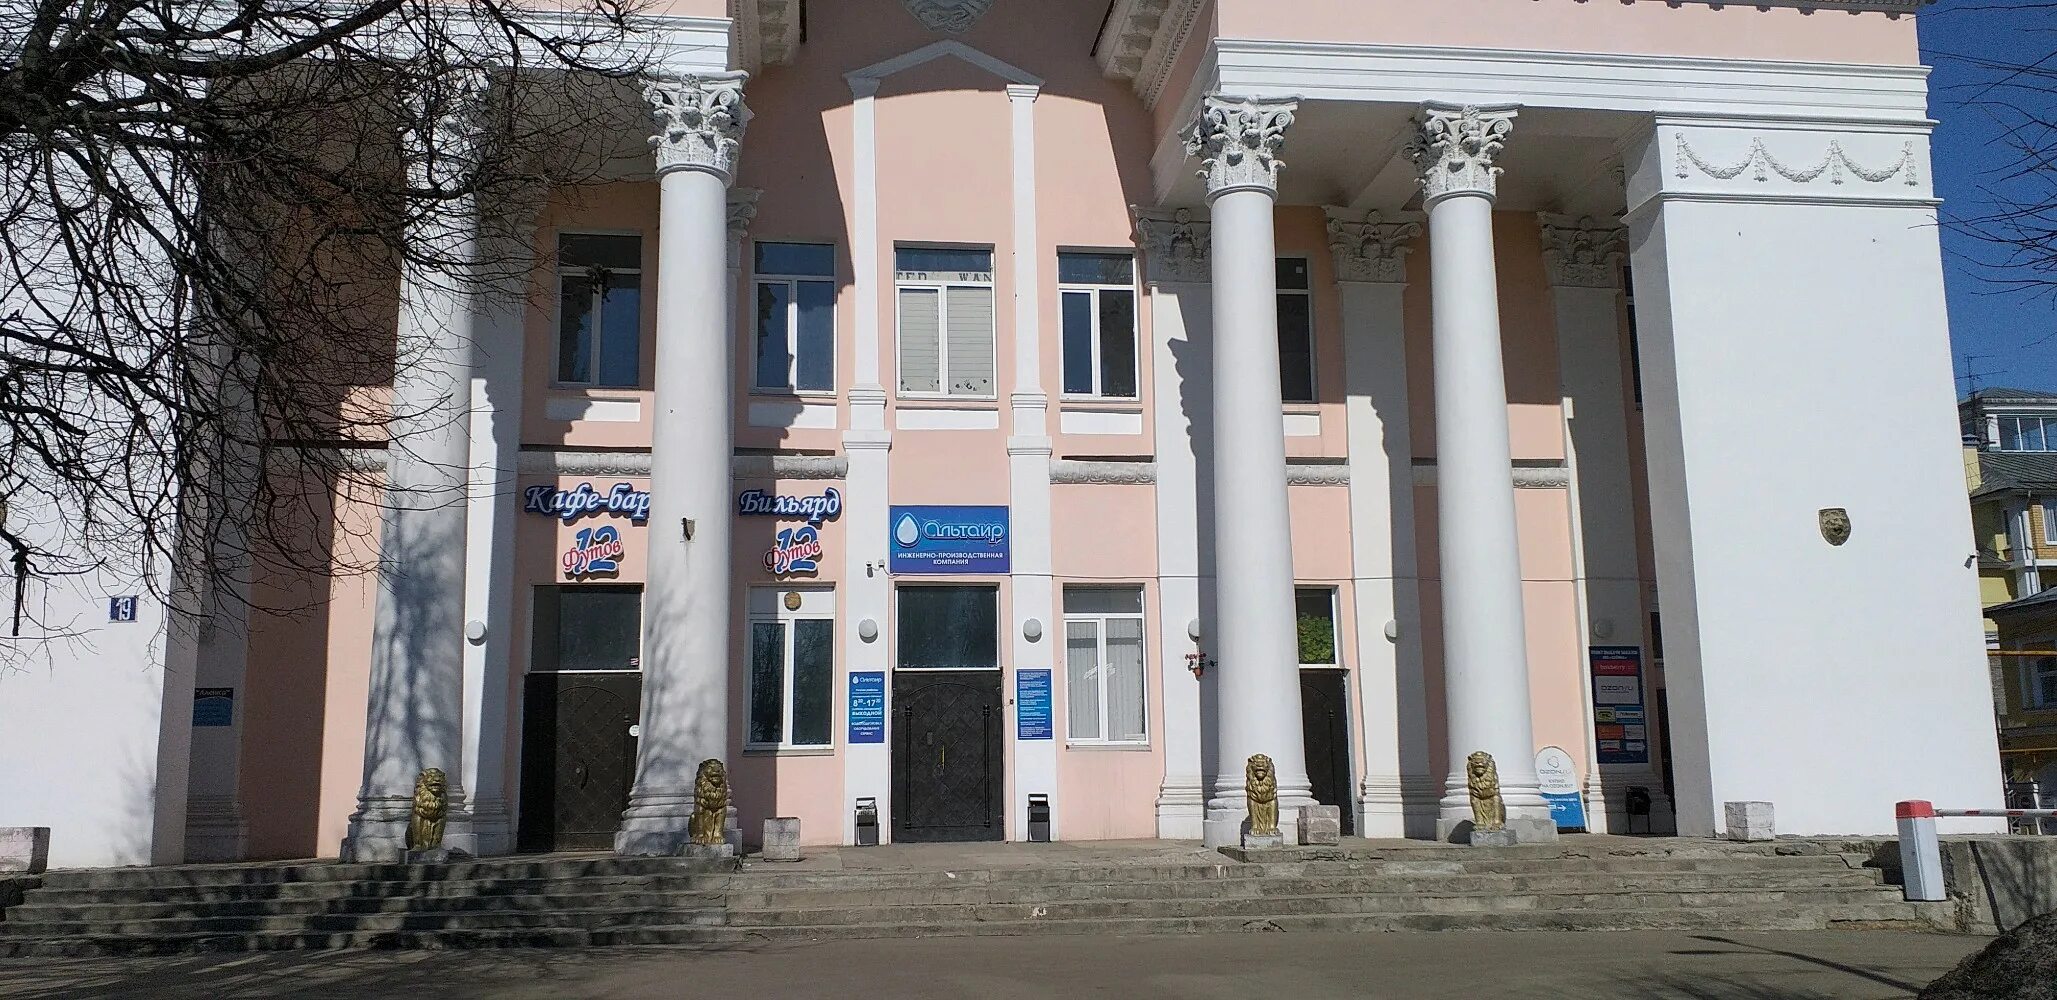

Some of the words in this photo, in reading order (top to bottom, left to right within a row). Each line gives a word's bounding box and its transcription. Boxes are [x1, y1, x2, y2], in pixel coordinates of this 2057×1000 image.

[525, 483, 650, 518] Кафе-бар
[740, 487, 842, 521] Бильярд
[575, 525, 619, 575] 12
[776, 525, 818, 574] 12
[115, 598, 131, 620] 19
